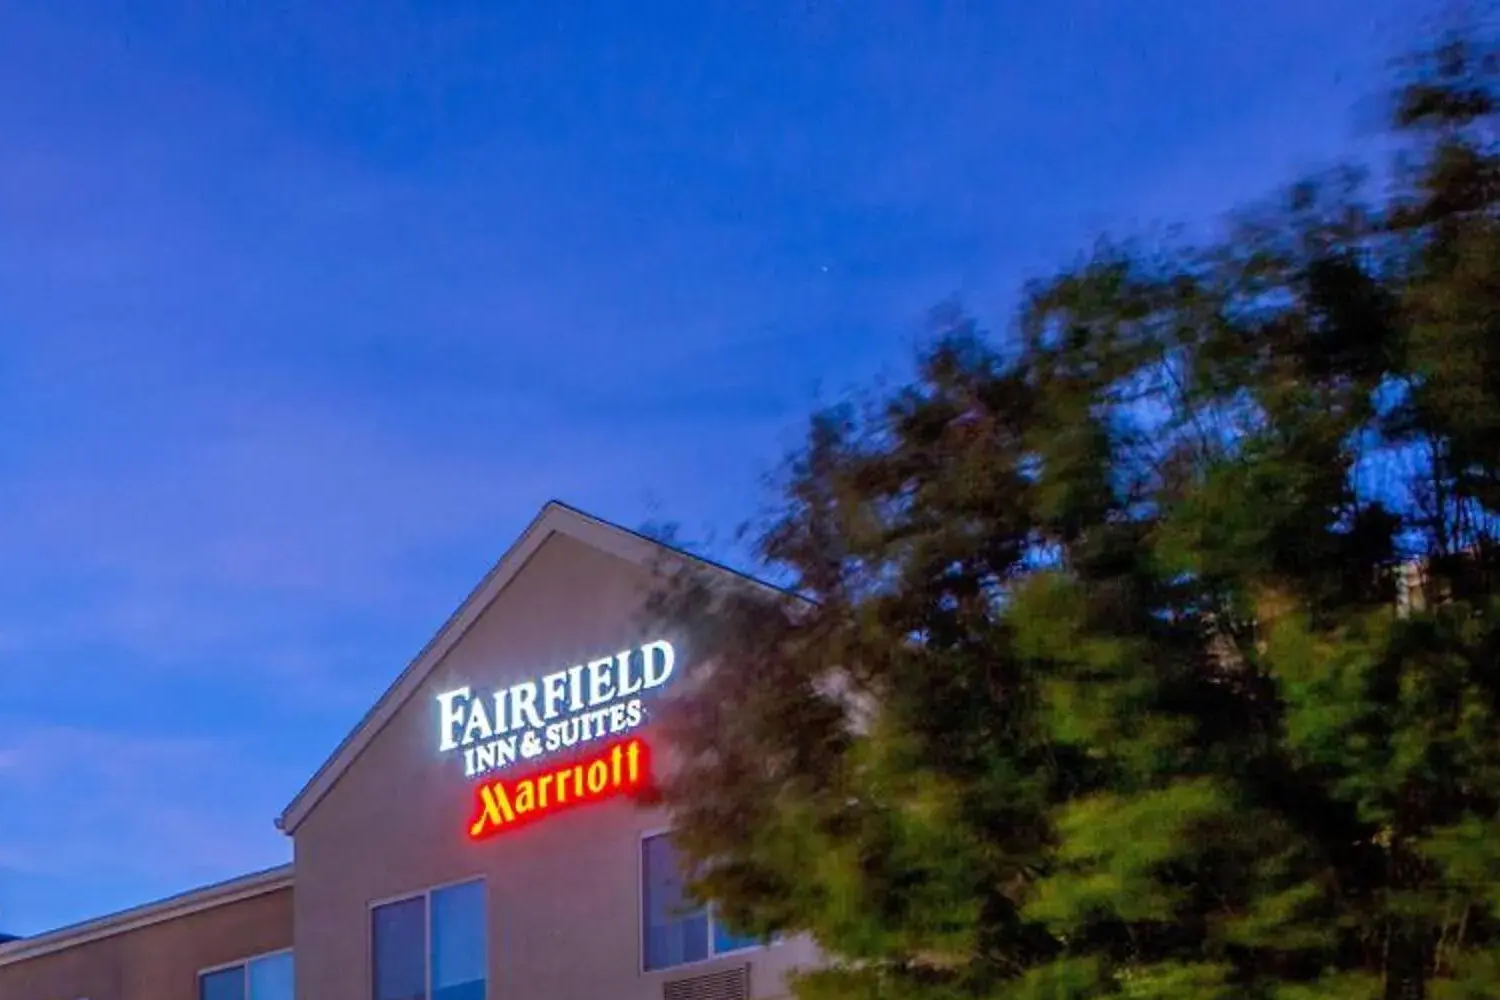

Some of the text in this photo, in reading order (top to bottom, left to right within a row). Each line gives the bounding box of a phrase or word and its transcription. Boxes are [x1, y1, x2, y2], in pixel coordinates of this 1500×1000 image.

[436, 639, 675, 752] FAIRFIELD
[464, 736, 517, 776] INN
[545, 699, 642, 751] SUITES
[470, 740, 640, 836] Marriott
